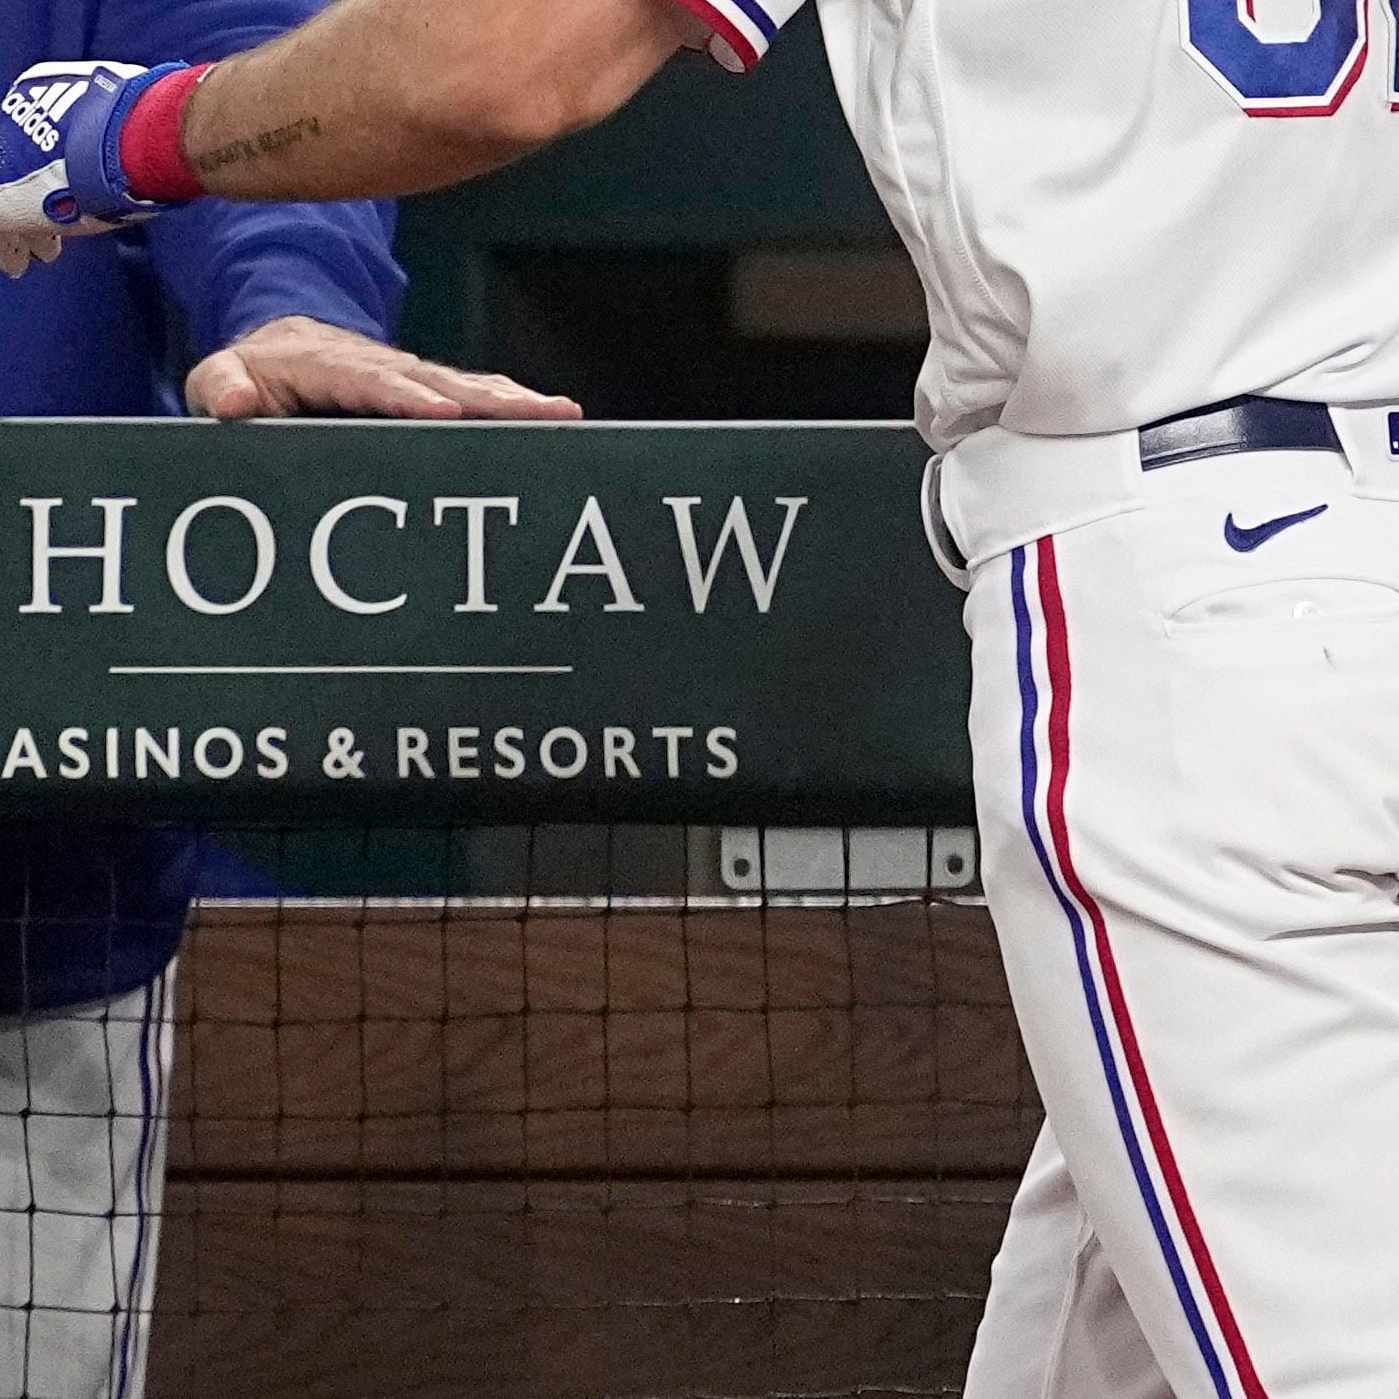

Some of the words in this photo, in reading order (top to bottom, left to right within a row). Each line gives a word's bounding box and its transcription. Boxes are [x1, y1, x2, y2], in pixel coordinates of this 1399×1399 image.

[1, 92, 60, 152] adidas
[322, 727, 366, 780] &
[397, 726, 739, 780] RESORTS
